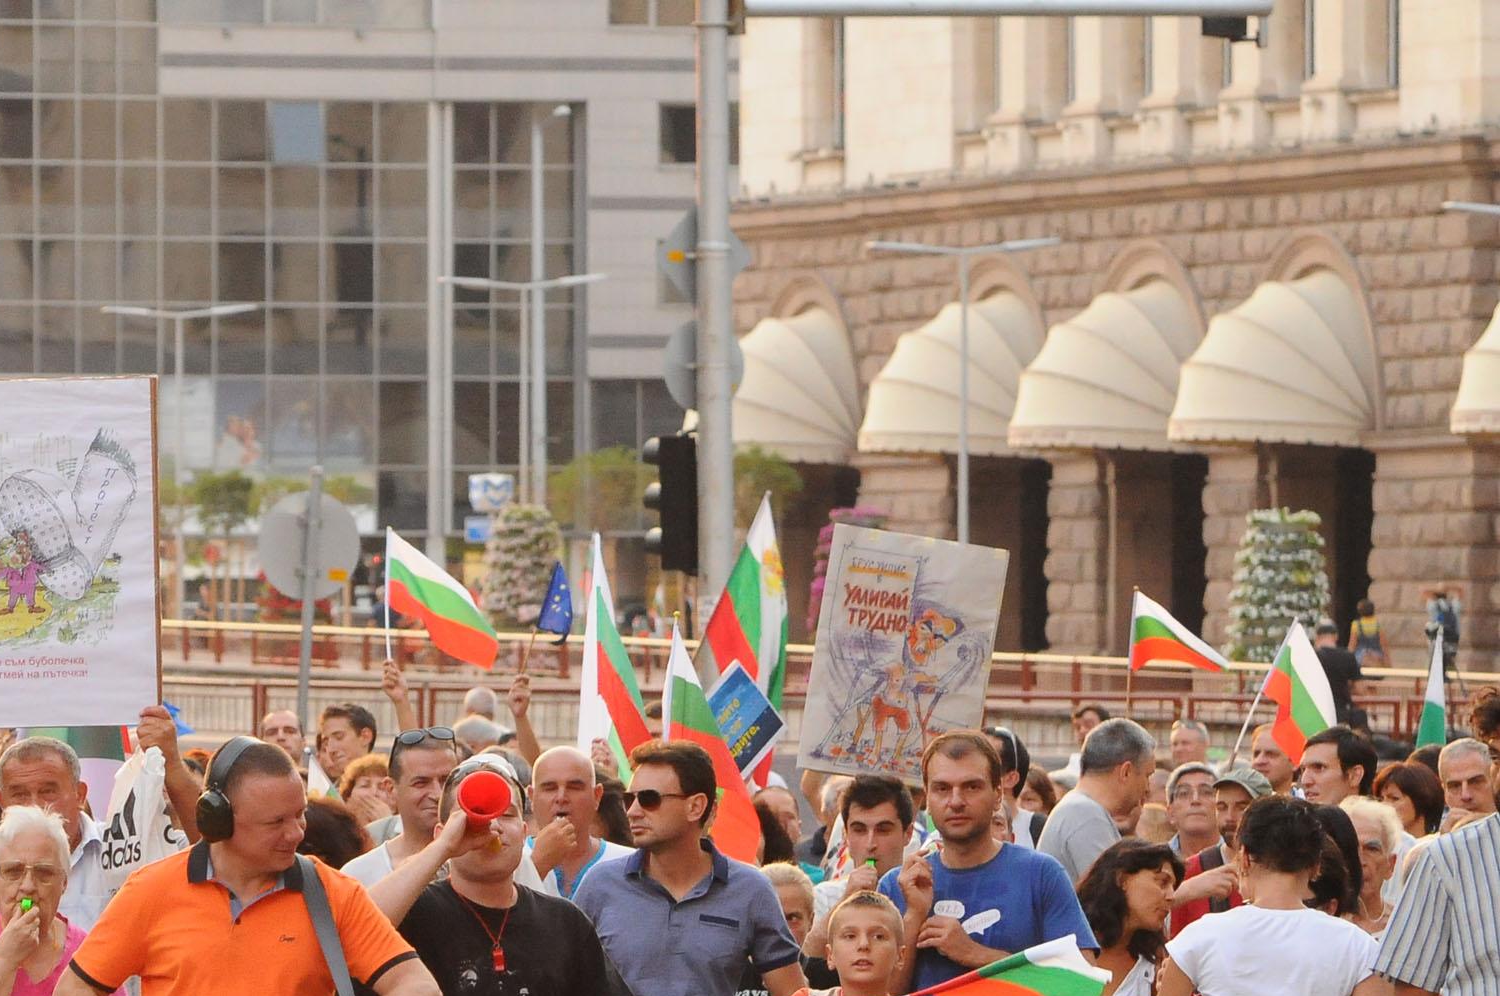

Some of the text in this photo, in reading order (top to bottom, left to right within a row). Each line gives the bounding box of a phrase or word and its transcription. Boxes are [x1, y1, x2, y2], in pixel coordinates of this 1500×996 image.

[844, 582, 909, 610] УМИРАЙ
[848, 607, 908, 634] ТРУДНО
[4, 657, 26, 666] съм
[27, 670, 40, 679] на
